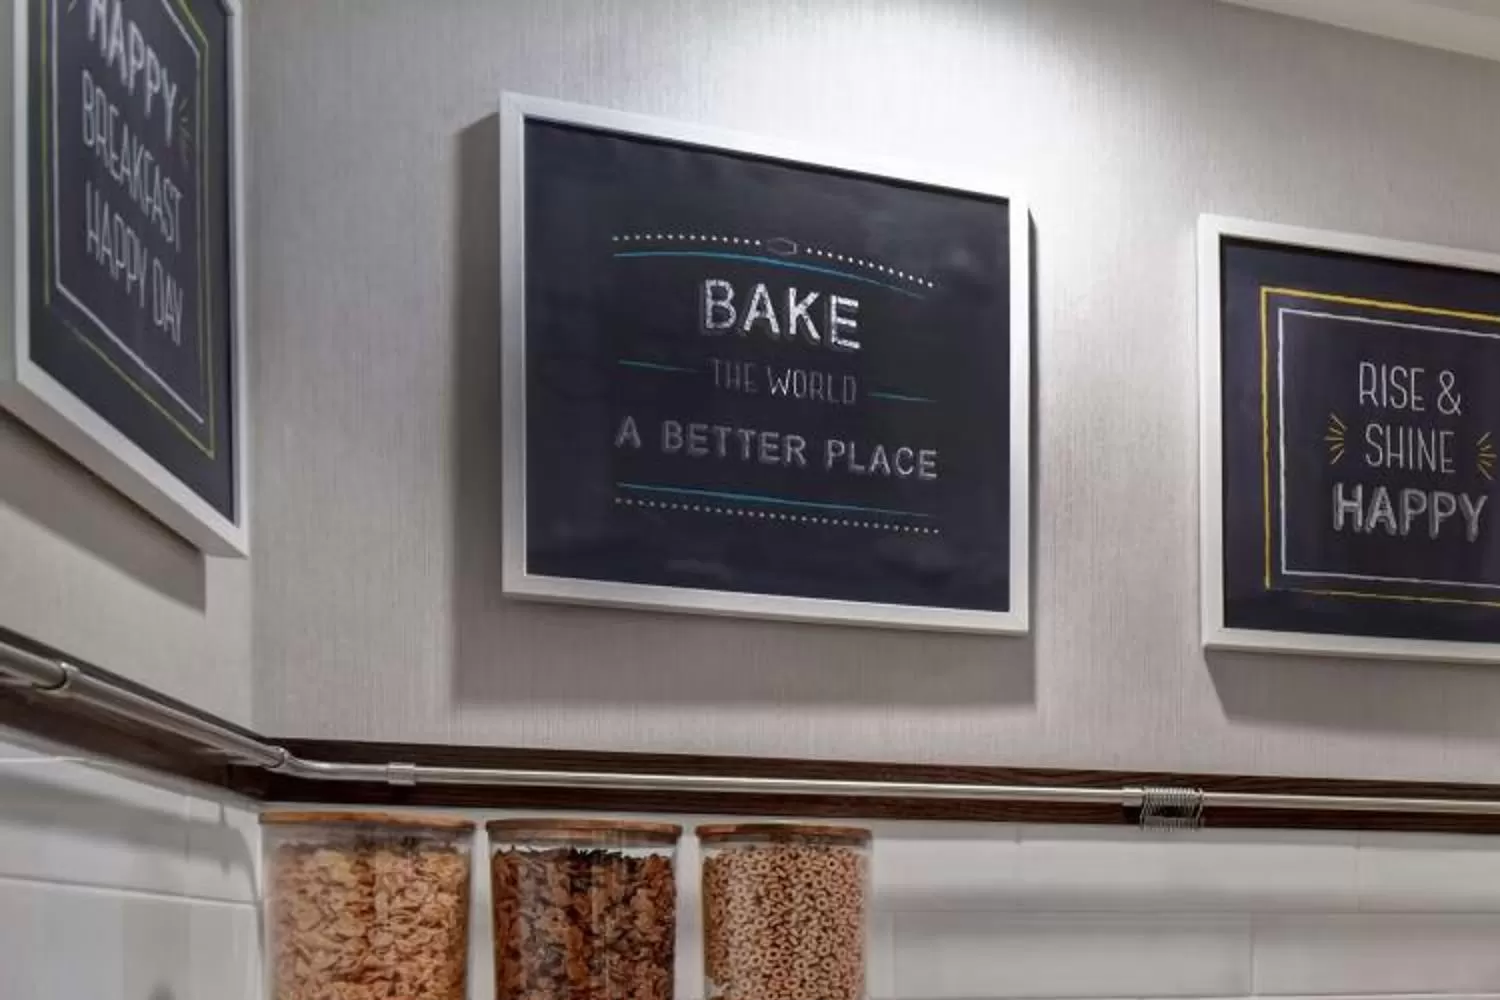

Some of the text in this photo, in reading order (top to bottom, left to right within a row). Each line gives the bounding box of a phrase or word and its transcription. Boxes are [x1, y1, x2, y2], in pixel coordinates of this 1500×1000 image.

[82, 69, 183, 252] BREAKFAST
[86, 179, 184, 346] HAPPY DAY
[702, 279, 861, 350] BAKE
[711, 358, 857, 404] THE WORLD
[1359, 361, 1462, 416] RISE &
[615, 415, 938, 480] A BETTER PLACE
[1365, 423, 1457, 474] SHINE
[1333, 482, 1488, 543] HAPPY
